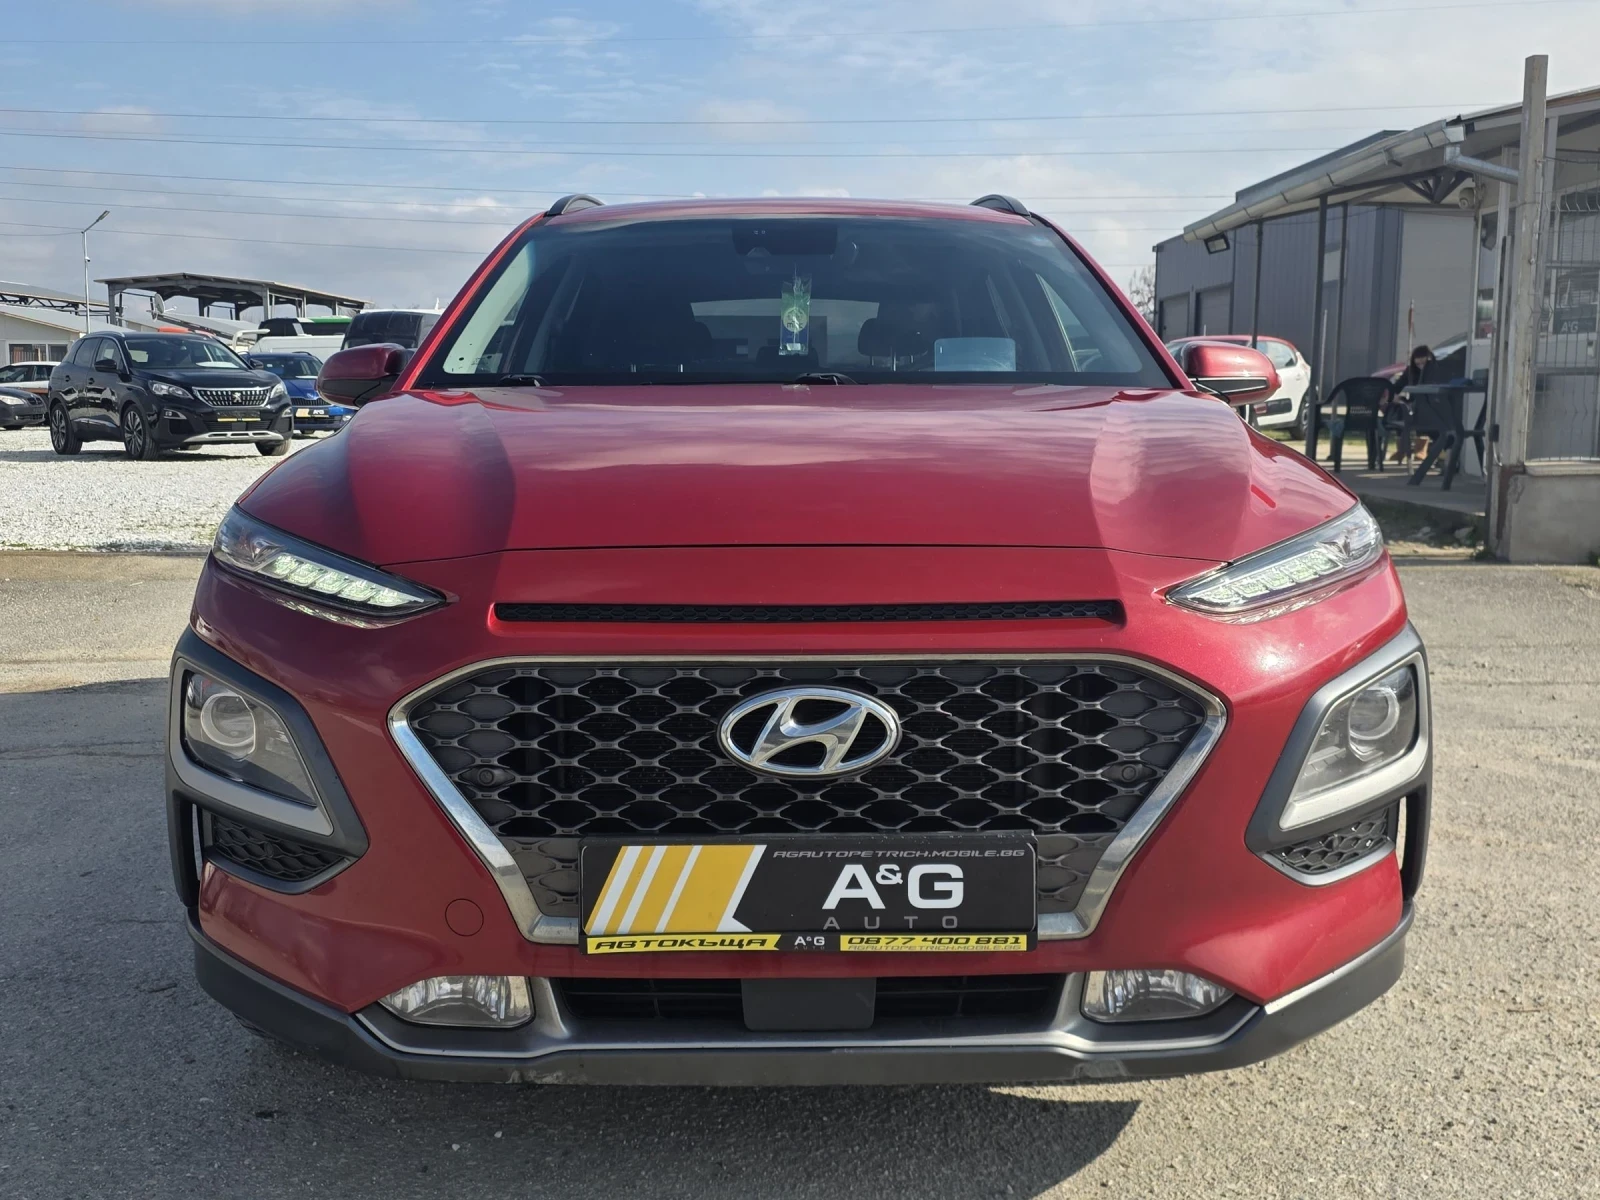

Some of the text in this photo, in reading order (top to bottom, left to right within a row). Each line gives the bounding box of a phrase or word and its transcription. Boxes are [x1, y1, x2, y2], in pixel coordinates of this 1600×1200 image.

[773, 849, 1025, 859] AGAUTOPETRICH.MOBILE.BG
[821, 863, 964, 910] A&G
[822, 915, 958, 930] AUTO
[595, 938, 767, 950] АВТОКЪЩА
[847, 937, 1022, 945] 0877 400 881
